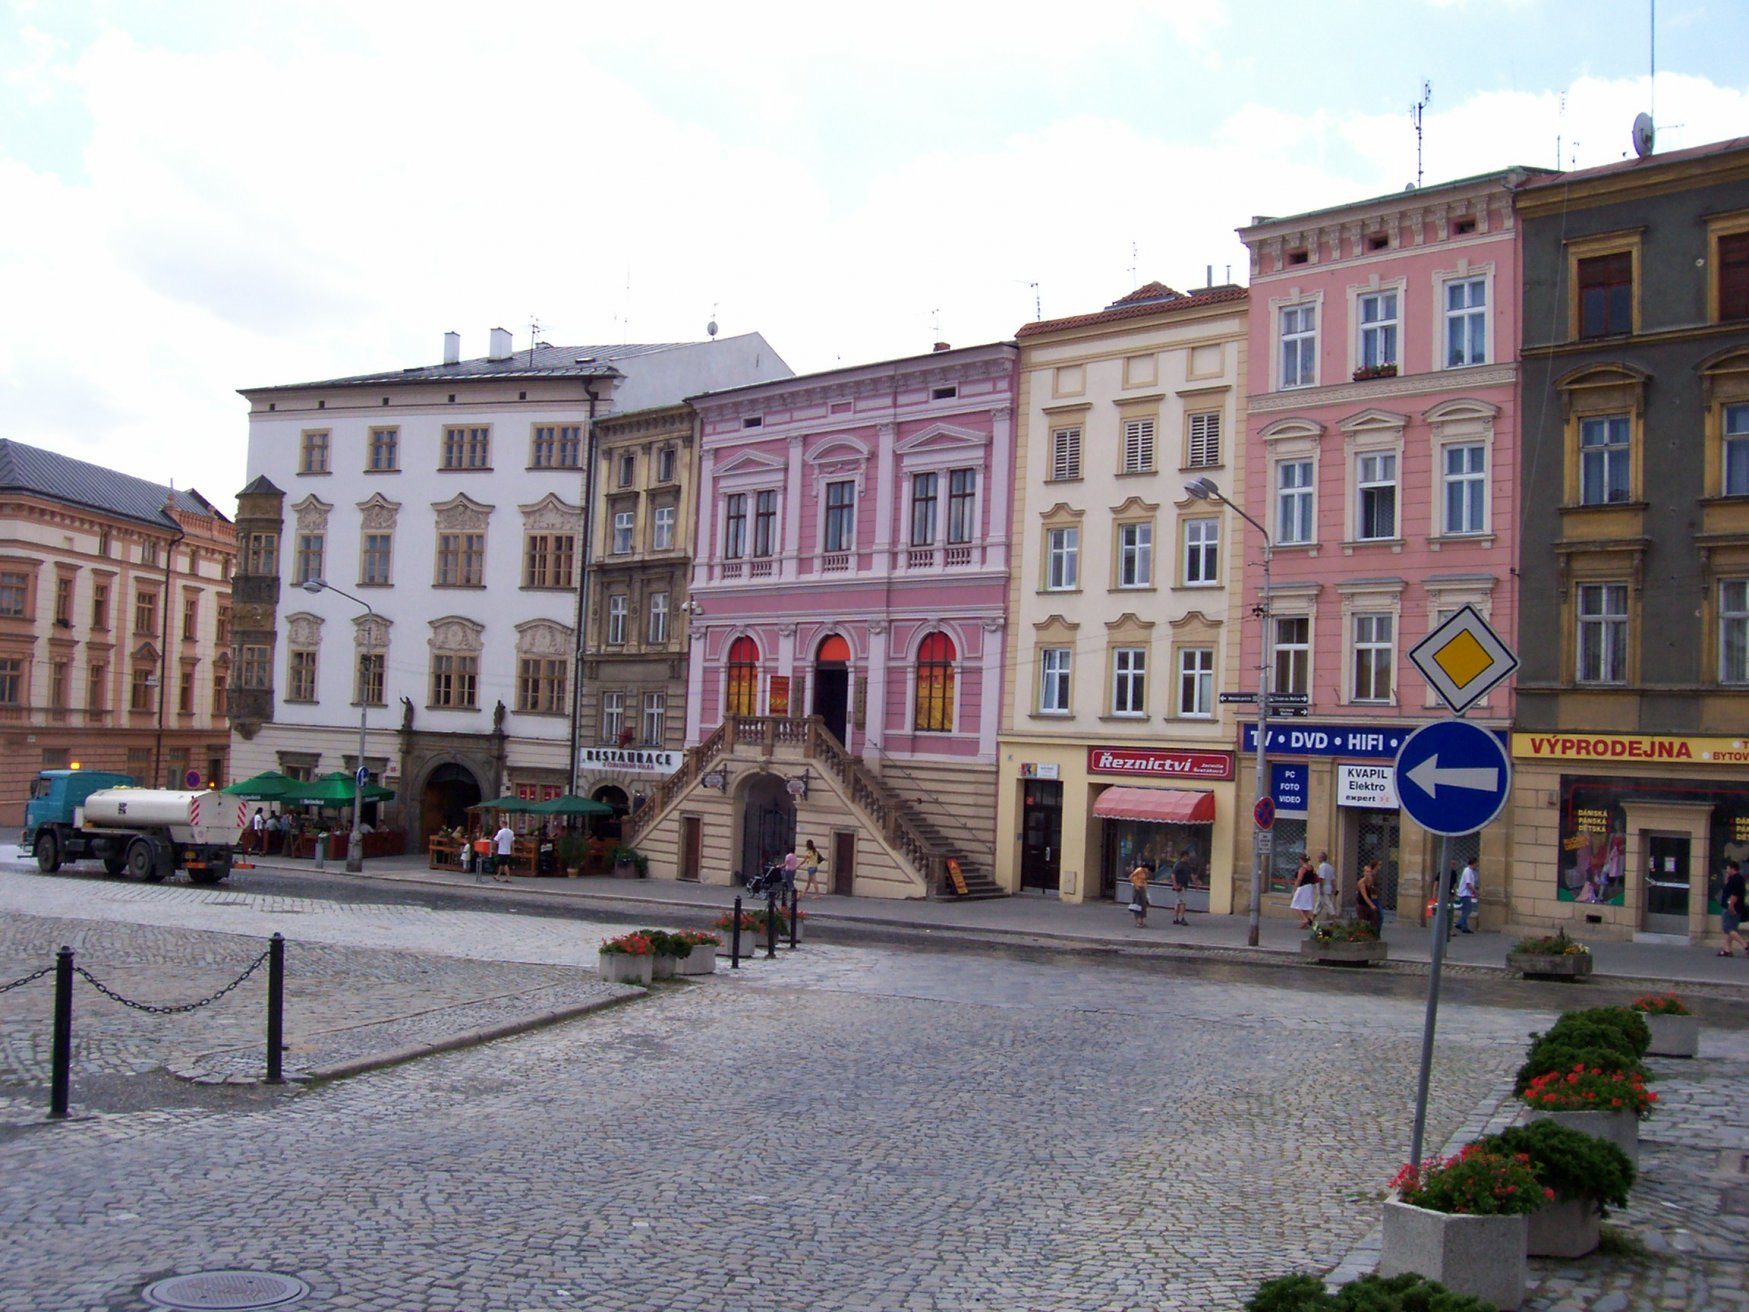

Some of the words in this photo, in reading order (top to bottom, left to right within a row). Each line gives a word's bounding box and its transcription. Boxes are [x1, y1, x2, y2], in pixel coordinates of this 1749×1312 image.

[1291, 732, 1328, 748] DVD
[1348, 734, 1383, 750] HIFI
[1530, 735, 1692, 759] VÝPRODEJNA
[586, 750, 672, 766] RESTAURACE
[1099, 752, 1192, 772] Řeznictví
[1285, 770, 1295, 778] PC
[1347, 768, 1388, 780] KVAPIL
[1280, 783, 1300, 791] FOTO
[1349, 781, 1385, 792] Elektro
[1279, 795, 1301, 803] VIDEO
[1345, 794, 1376, 802] expert
